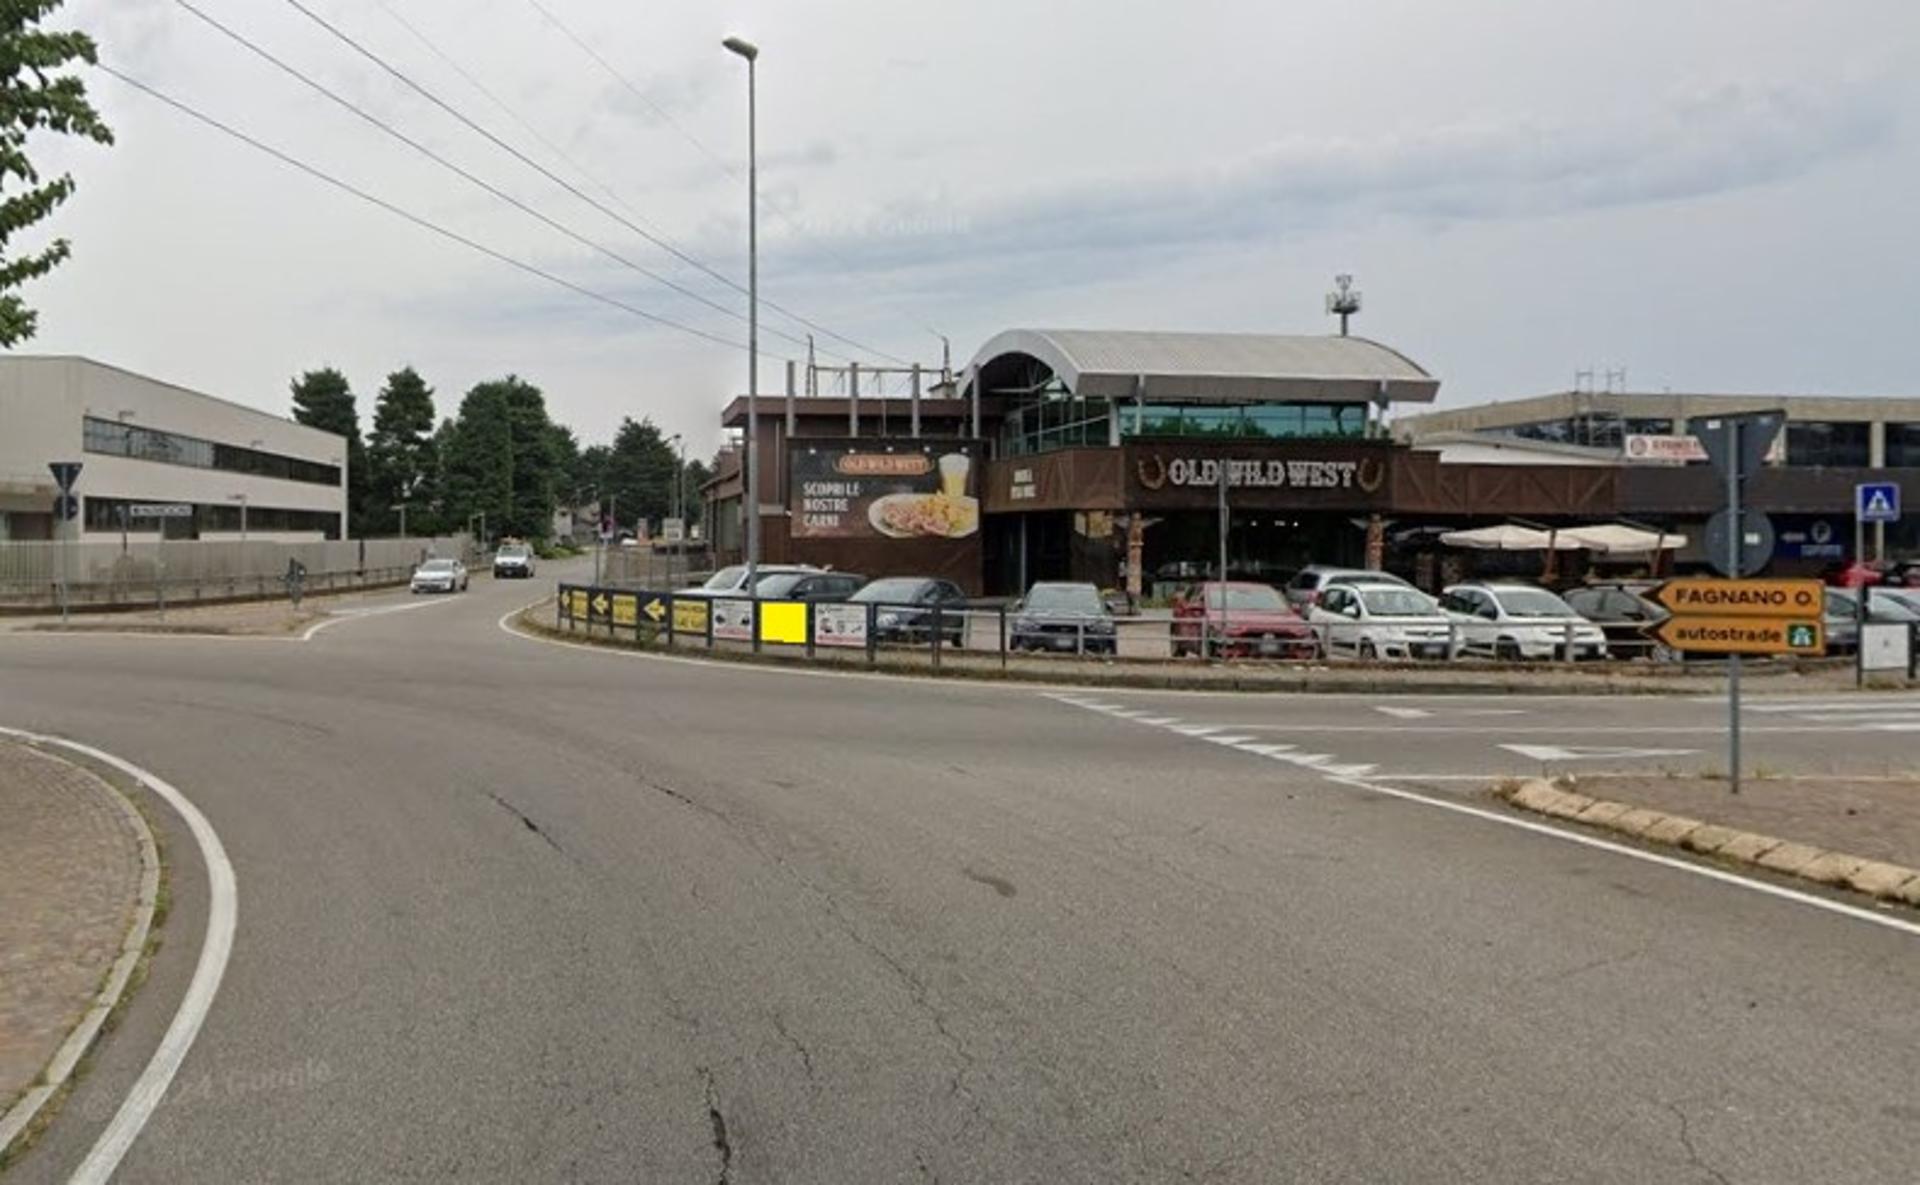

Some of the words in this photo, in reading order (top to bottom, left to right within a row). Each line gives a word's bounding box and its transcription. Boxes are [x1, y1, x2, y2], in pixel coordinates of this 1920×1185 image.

[1168, 458, 1218, 486] OLD
[1224, 458, 1286, 487] WILD
[1287, 460, 1357, 488] WEST
[803, 481, 845, 497] SCOPRI
[846, 481, 860, 497] LE
[803, 498, 849, 512] NOSTRE
[803, 513, 839, 527] CARNI
[1675, 588, 1788, 605] FAGNANO
[1677, 625, 1781, 644] autostrade
